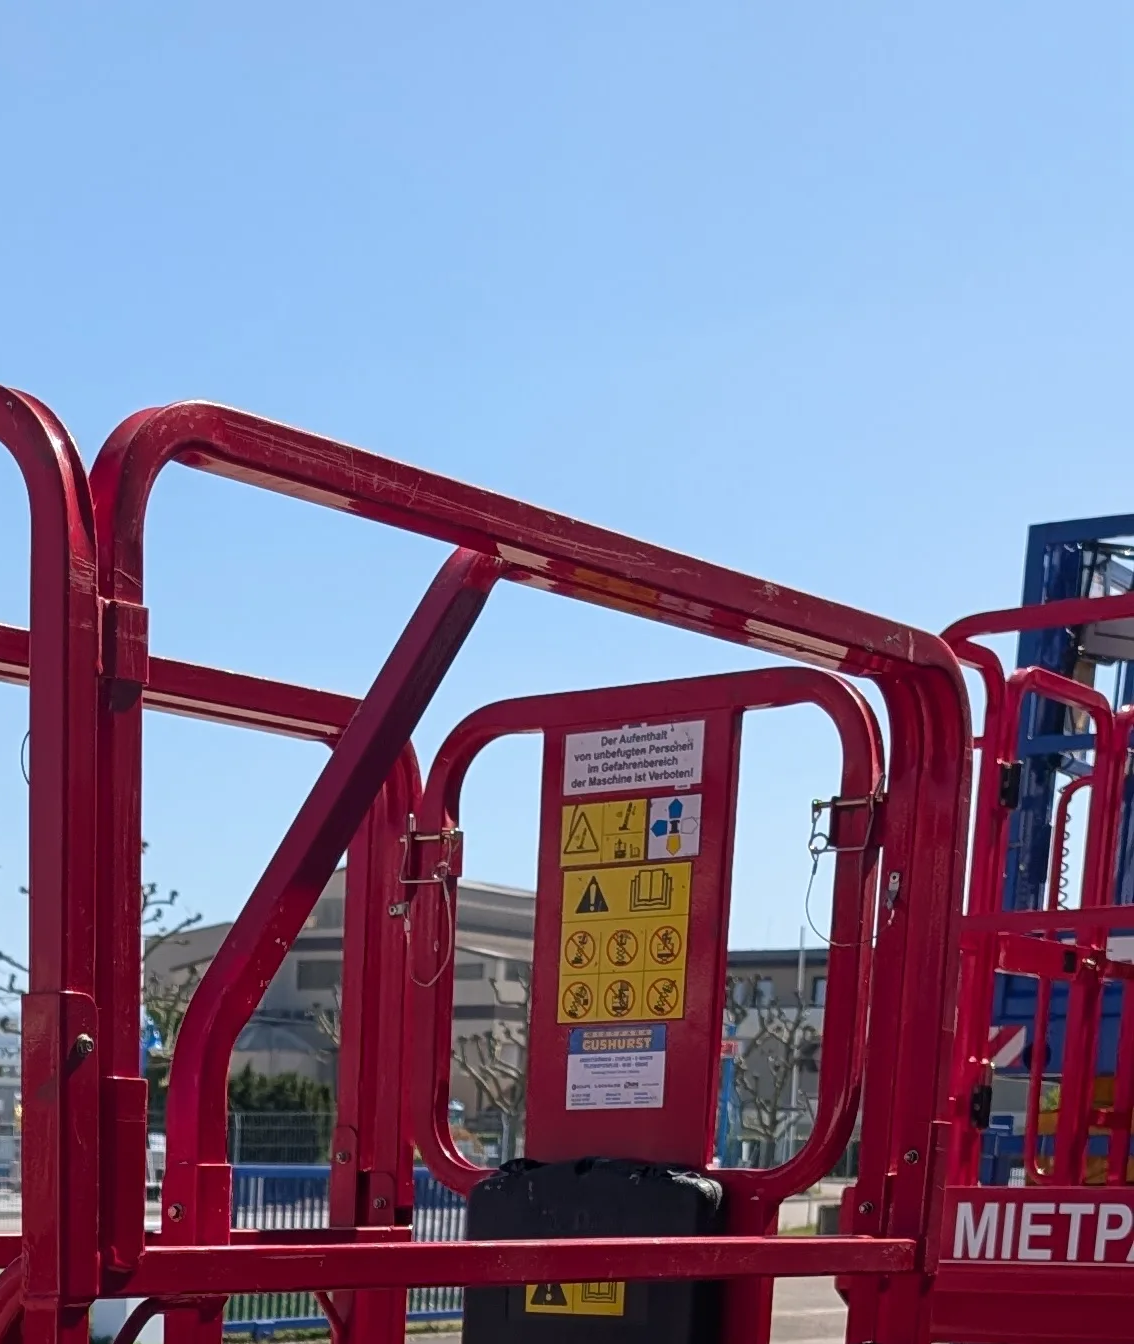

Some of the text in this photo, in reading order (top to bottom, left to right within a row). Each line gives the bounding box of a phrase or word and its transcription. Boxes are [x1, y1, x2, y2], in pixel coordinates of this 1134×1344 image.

[601, 730, 667, 746] Der Aufenthalt
[574, 742, 694, 762] von unbefugten Personen
[588, 756, 678, 773] im Gefahrenbereich
[571, 768, 694, 789] der Maschine ist Verboten!
[582, 1037, 652, 1051] GUSHURST
[952, 1201, 1134, 1262] MIETP
